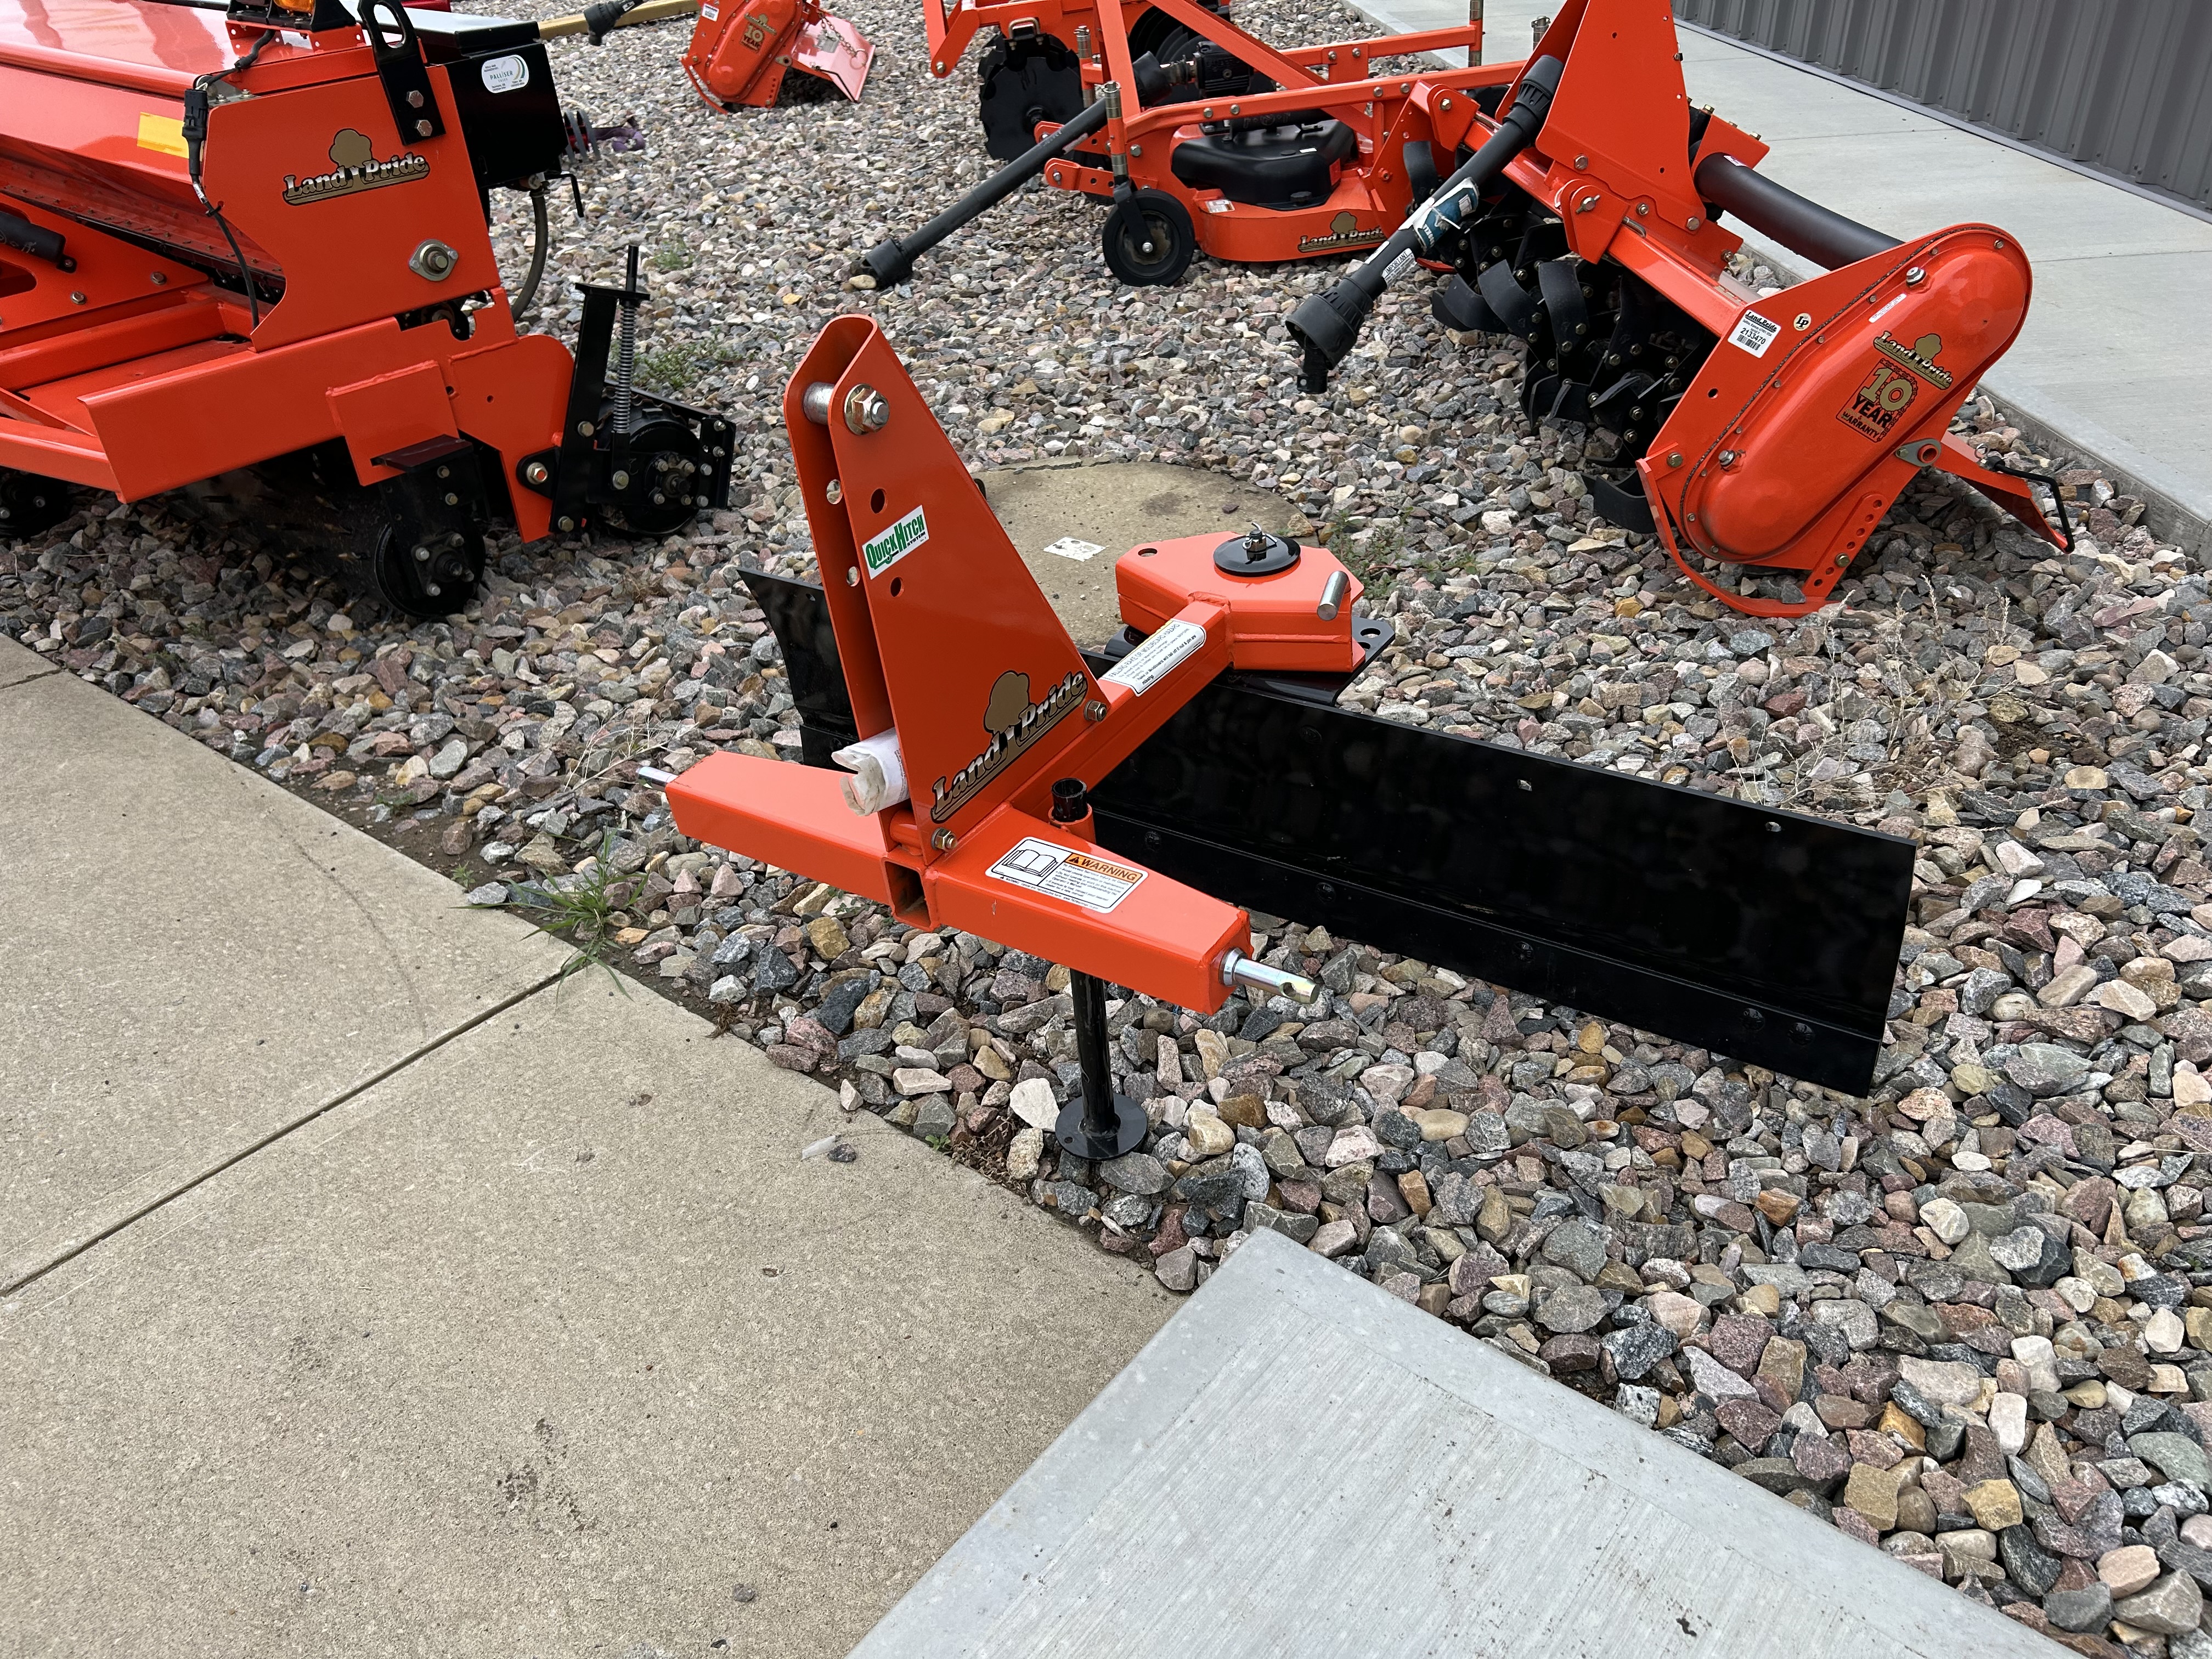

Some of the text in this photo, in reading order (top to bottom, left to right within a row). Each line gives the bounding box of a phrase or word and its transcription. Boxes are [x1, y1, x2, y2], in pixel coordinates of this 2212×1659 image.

[745, 25, 763, 42] 10
[489, 70, 513, 80] PALLISER
[284, 151, 426, 197] Land Pride
[1301, 232, 1338, 247] Land
[1385, 251, 1408, 274] IMPORTANT
[1746, 312, 1777, 332] Land Pride
[1796, 317, 1809, 328] LP
[1740, 328, 1766, 345] 2133470
[1876, 331, 1953, 386] Land Pride
[1860, 367, 1913, 411] 10
[1851, 394, 1893, 429] YEAR
[1841, 411, 1880, 438] WARRANTY
[907, 532, 926, 547] SYSTEM
[933, 732, 1002, 815] Land
[1018, 672, 1085, 742] Pride
[1081, 859, 1137, 880] WARNING
